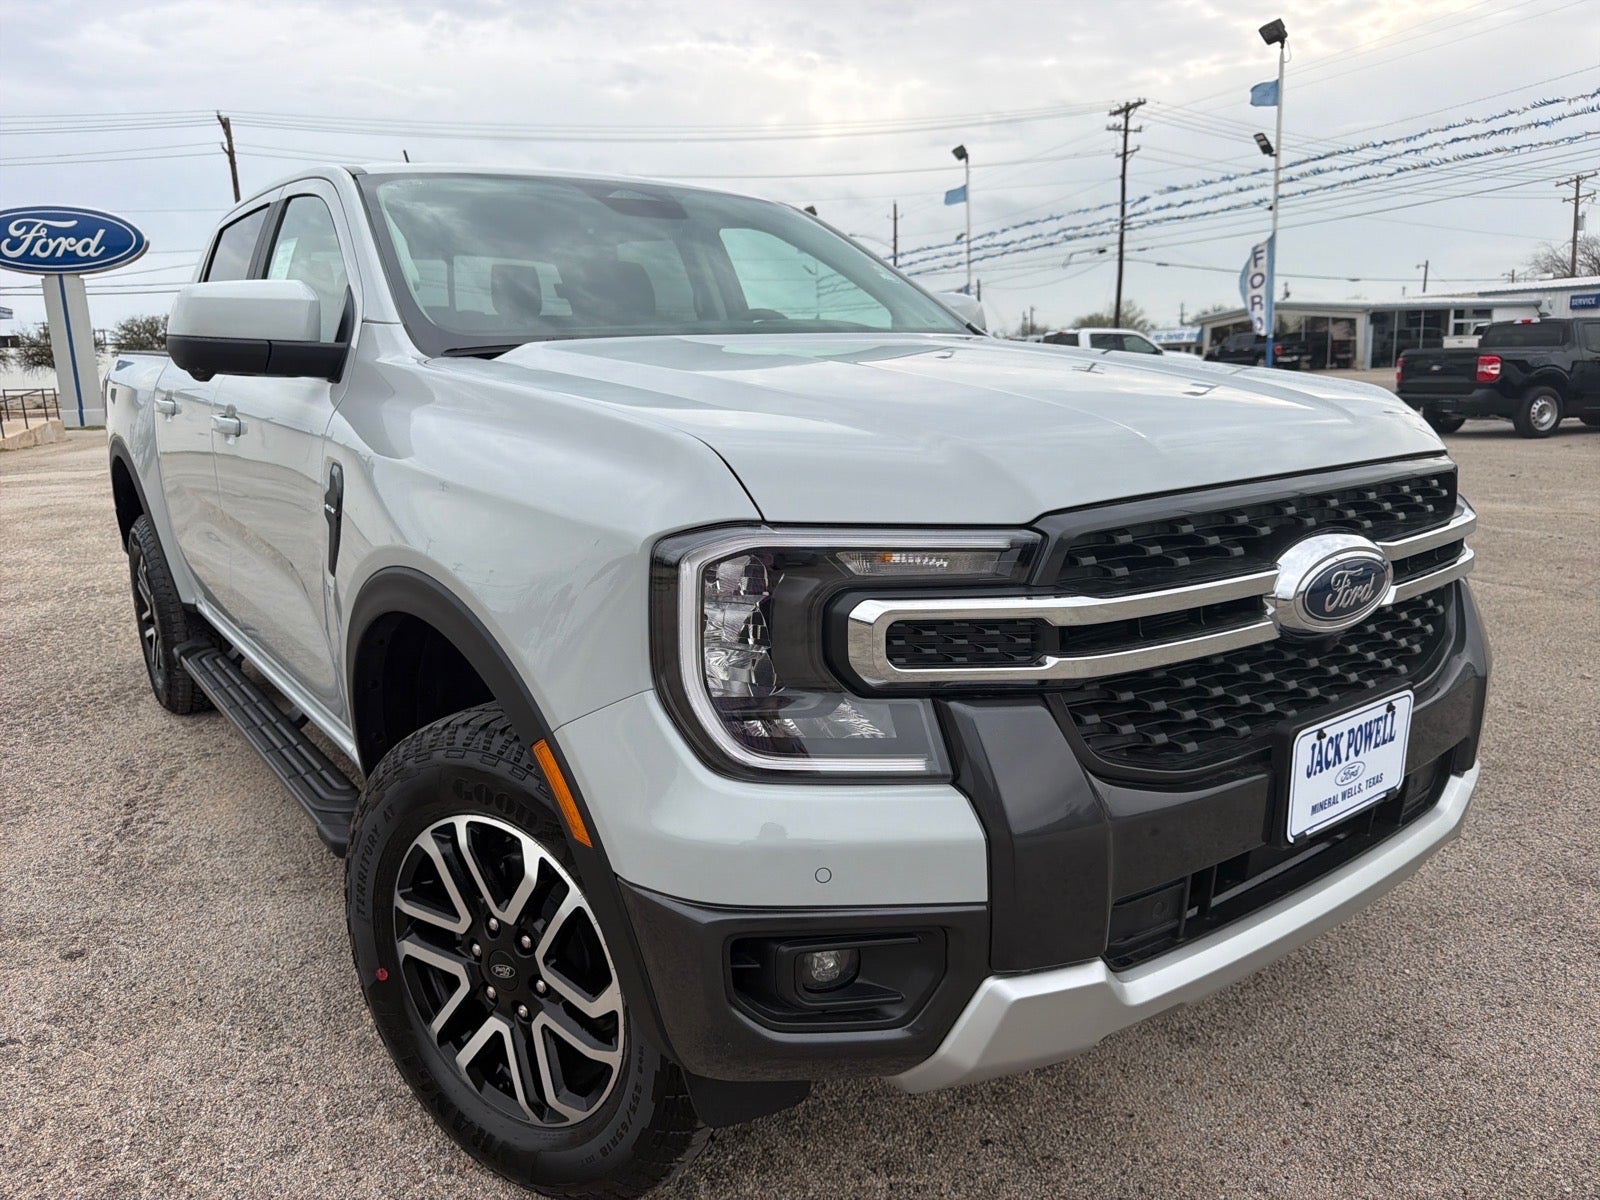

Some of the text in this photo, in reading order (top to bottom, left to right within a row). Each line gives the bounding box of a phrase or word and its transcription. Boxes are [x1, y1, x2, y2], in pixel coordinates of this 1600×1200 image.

[1, 218, 106, 258] Ford
[1325, 567, 1375, 613] Ford
[1306, 710, 1396, 779] JACK POWELL
[1311, 794, 1339, 816] MINERAL
[1365, 773, 1384, 790] TEXAS
[1341, 765, 1361, 783] Ford
